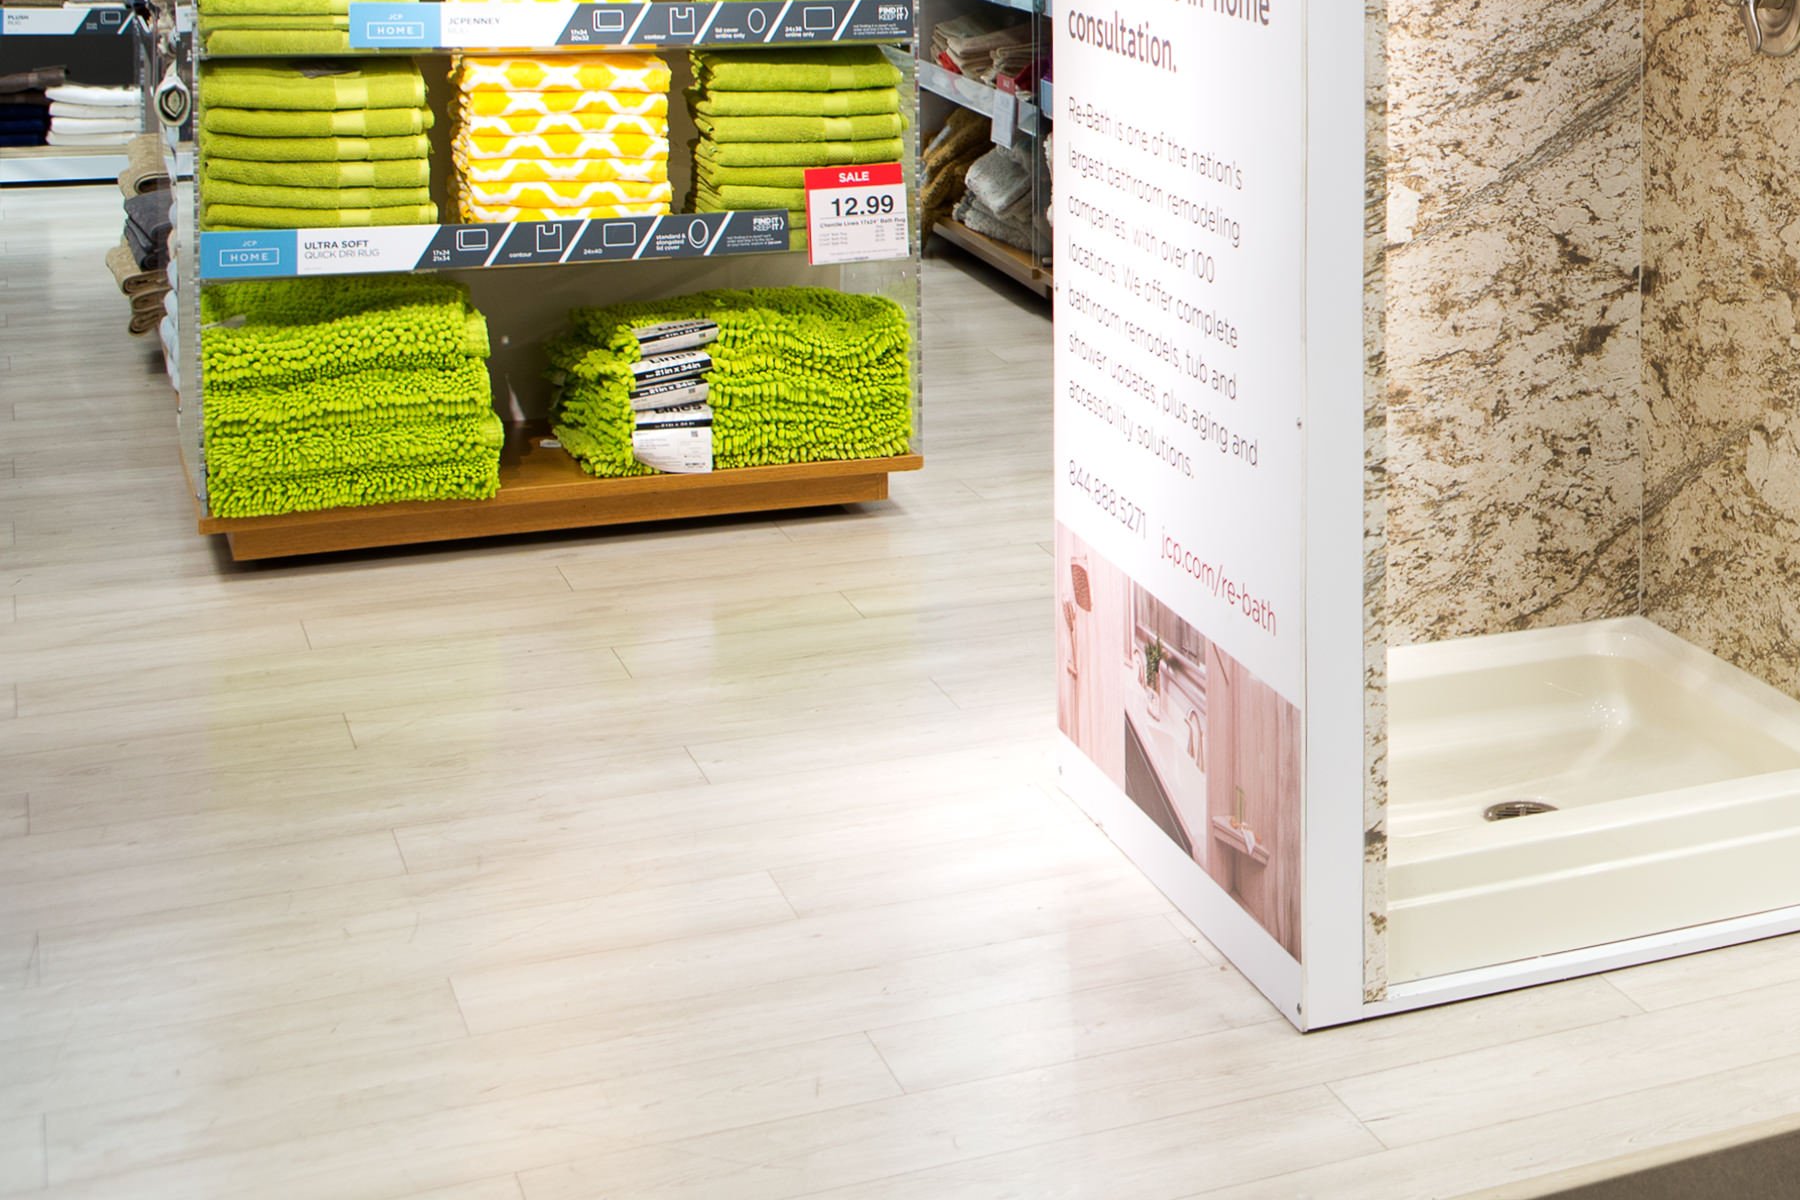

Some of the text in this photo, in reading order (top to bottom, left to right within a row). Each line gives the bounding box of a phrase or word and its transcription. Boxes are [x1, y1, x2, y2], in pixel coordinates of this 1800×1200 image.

[377, 26, 414, 35] HOME
[449, 17, 500, 25] JCPENNEY
[1068, 9, 1177, 73] consultation.
[1069, 96, 1243, 191] Re-Bath is one of the nation's
[839, 171, 870, 183] SALE
[1068, 141, 1105, 182] largest
[1167, 193, 1241, 249] remodeling
[831, 194, 894, 217] 12.99
[230, 253, 269, 262] HOME
[305, 240, 369, 249] ULTRA SOFT
[305, 249, 380, 259] QUICK DRI RUG
[1161, 240, 1188, 271] over
[1191, 248, 1215, 284] 100
[1123, 263, 1141, 297] We
[1145, 278, 1173, 313] offer
[1176, 299, 1238, 349] complete
[649, 352, 696, 364] Lines
[1068, 280, 1237, 401] bathroom remodels, tub and
[1068, 330, 1108, 372] shower
[1161, 388, 1189, 425] plus
[1191, 408, 1229, 454] aging
[1231, 433, 1258, 469] and
[1068, 378, 1195, 480] accessibility solutions.
[1068, 459, 1147, 540] 844.888.5271
[1160, 525, 1277, 637] jcp.com/re-bath
